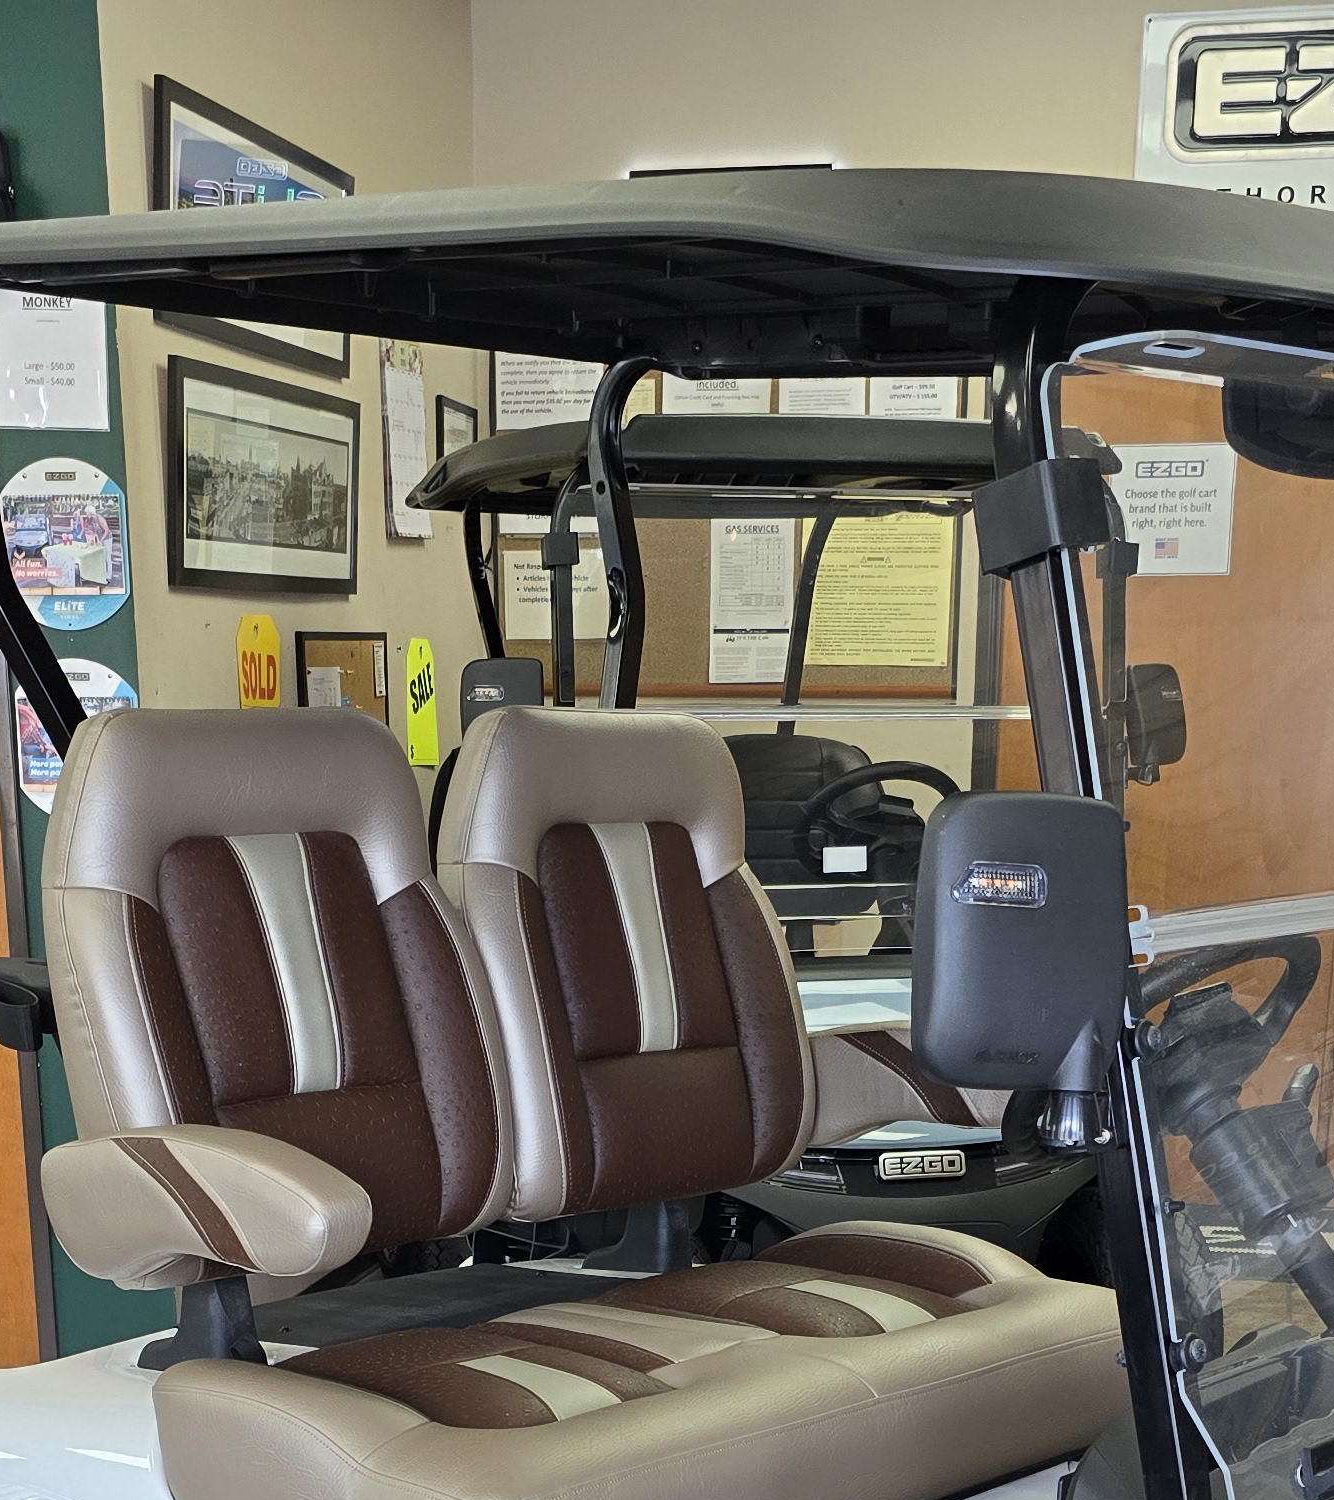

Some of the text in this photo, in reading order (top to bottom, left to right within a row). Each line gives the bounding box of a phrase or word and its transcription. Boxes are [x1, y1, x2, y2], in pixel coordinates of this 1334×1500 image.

[22, 296, 72, 308] MONKEY
[24, 362, 44, 371] Large
[50, 362, 75, 371] $50.00
[25, 377, 44, 385] Small
[51, 377, 75, 386] $40.00
[1125, 488, 1217, 500] Choose the golf cart
[1129, 502, 1211, 513] brand that is built
[725, 525, 779, 533] GAS SERVICES
[1132, 517, 1206, 530] right, right here.
[15, 560, 42, 568] All fun.
[15, 569, 59, 577] No worries.
[241, 650, 277, 700] SOLD
[410, 662, 433, 714] SALE
[410, 745, 415, 759] $
